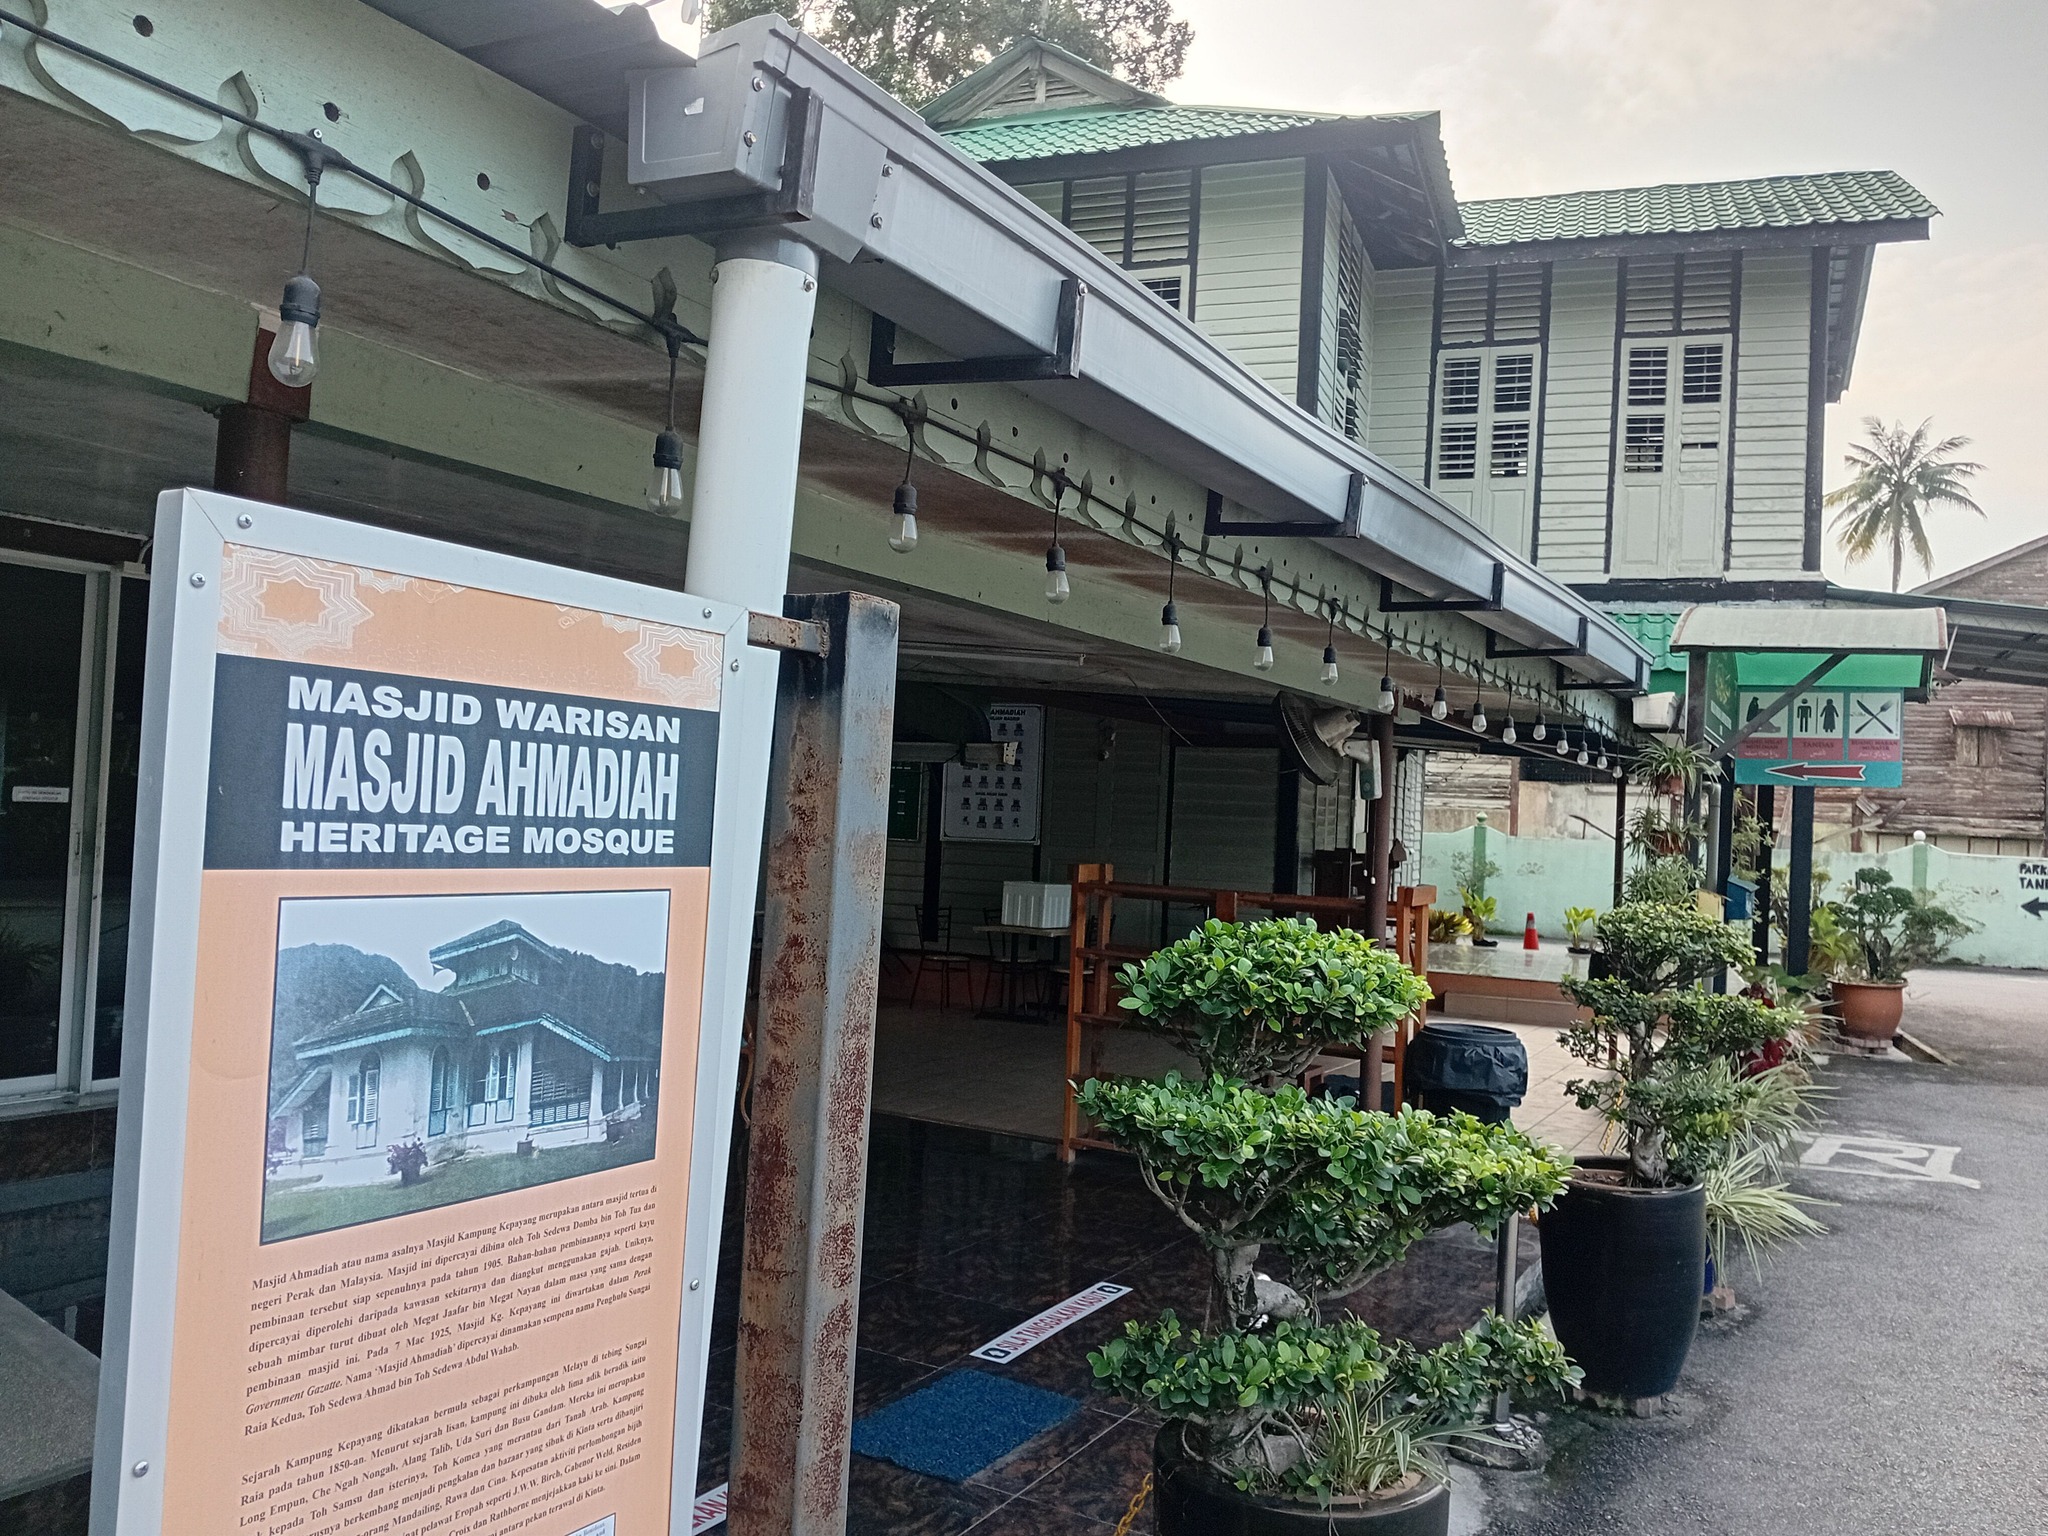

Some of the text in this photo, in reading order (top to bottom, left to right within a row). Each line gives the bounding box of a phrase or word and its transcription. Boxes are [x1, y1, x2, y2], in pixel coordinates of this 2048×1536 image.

[288, 675, 681, 744] MASJID WARISAN
[1803, 741, 1834, 749] TANDAS
[282, 722, 680, 821] MASJID AHMADIAH
[280, 821, 675, 856] HERITAGE MOSQUE
[249, 1311, 305, 1335] pembinaan
[309, 1299, 348, 1317] tersebut
[352, 1294, 371, 1306] siap
[375, 1280, 427, 1301] sepenuhnya
[430, 1272, 452, 1288] pada
[455, 1266, 479, 1279] tahun
[507, 1245, 557, 1265] Bahan-bahan
[250, 1230, 541, 1312] negeri Perak dan Malaysia. Masjid ini dipercayai dibina oleh Toh
[252, 1216, 537, 1291] Masjid Ahmadiah atau nama asalnya Masjid Kampung Kepayang
[246, 1372, 302, 1398] pembinaan
[307, 1358, 340, 1377] masjid
[345, 1353, 361, 1366] ini.
[366, 1345, 389, 1360] Pada
[394, 1340, 401, 1350] 7
[406, 1336, 425, 1348] Mac
[457, 1315, 485, 1333] Masjid
[509, 1299, 547, 1317] Kepayang
[550, 1293, 561, 1305] ini
[247, 1284, 541, 1374] sebuah mimbar turut dibuat oleh Megat Jaafar bin Megat Nayan
[248, 1265, 544, 1354] dipercayai diperolehi daripada kawasan sekitarnya dan diangkut
[995, 1290, 1111, 1351] SILA TANGGALKAN KASUT
[244, 1421, 268, 1437] Raia
[270, 1411, 306, 1428] Kedua,
[307, 1402, 326, 1416] Toh
[327, 1393, 363, 1410] Sedewa
[364, 1379, 397, 1399] Ahmad
[398, 1376, 413, 1388] bin
[414, 1369, 431, 1382] Toh
[432, 1361, 463, 1377] Sedewa
[464, 1350, 489, 1367] Abdul
[245, 1390, 305, 1415] Government
[306, 1380, 343, 1397] Gazatte.
[345, 1370, 372, 1385] Nama
[456, 1329, 498, 1351] dipercayai
[499, 1318, 542, 1338] dinamakan
[239, 1511, 266, 1528] Long
[269, 1496, 309, 1517] Empun,
[311, 1487, 332, 1500] Che
[334, 1475, 359, 1493] Ngah
[361, 1462, 399, 1483] Nongah,
[401, 1452, 427, 1468] Alang
[456, 1435, 473, 1448] Uda
[474, 1426, 492, 1441] Suri
[494, 1422, 509, 1434] dan
[511, 1414, 531, 1428] Busu
[240, 1490, 265, 1507] Raia
[268, 1480, 293, 1500] pada
[296, 1470, 325, 1487] tahun
[329, 1456, 367, 1475] 1850-an.
[370, 1439, 410, 1461] Menurut
[412, 1426, 443, 1446] sejarah
[470, 1405, 507, 1425] kampung
[509, 1399, 520, 1411] ini
[522, 1391, 548, 1406] dibuka
[550, 1383, 566, 1396] oleh
[241, 1370, 559, 1486] Sejarah Kampung Kepayang dikatakan bermula sebagai perkampungan
[269, 1516, 305, 1536] kepada
[309, 1506, 328, 1521] Toh
[332, 1495, 363, 1513] Samsu
[367, 1487, 385, 1500] dan
[432, 1461, 448, 1475] Toh
[483, 1442, 504, 1458] yang
[506, 1427, 543, 1447] merantau
[545, 1417, 561, 1432] dari
[343, 1499, 399, 1528] berkembang
[401, 1483, 436, 1505] menjadi
[437, 1469, 479, 1494] pengkalan
[480, 1462, 496, 1474] dan
[497, 1451, 524, 1468] bazaar
[525, 1443, 544, 1459] yang
[545, 1434, 565, 1449] sibuk
[420, 1514, 453, 1536] pelawat
[454, 1500, 484, 1520] Eropah
[485, 1488, 512, 1508] seperti
[445, 1491, 468, 1506] Rawa
[469, 1484, 485, 1496] dan
[510, 1459, 549, 1480] Kepesatan
[472, 1518, 488, 1530] dan
[489, 1500, 530, 1523] Rathborne
[499, 1510, 548, 1536] antara pekan
